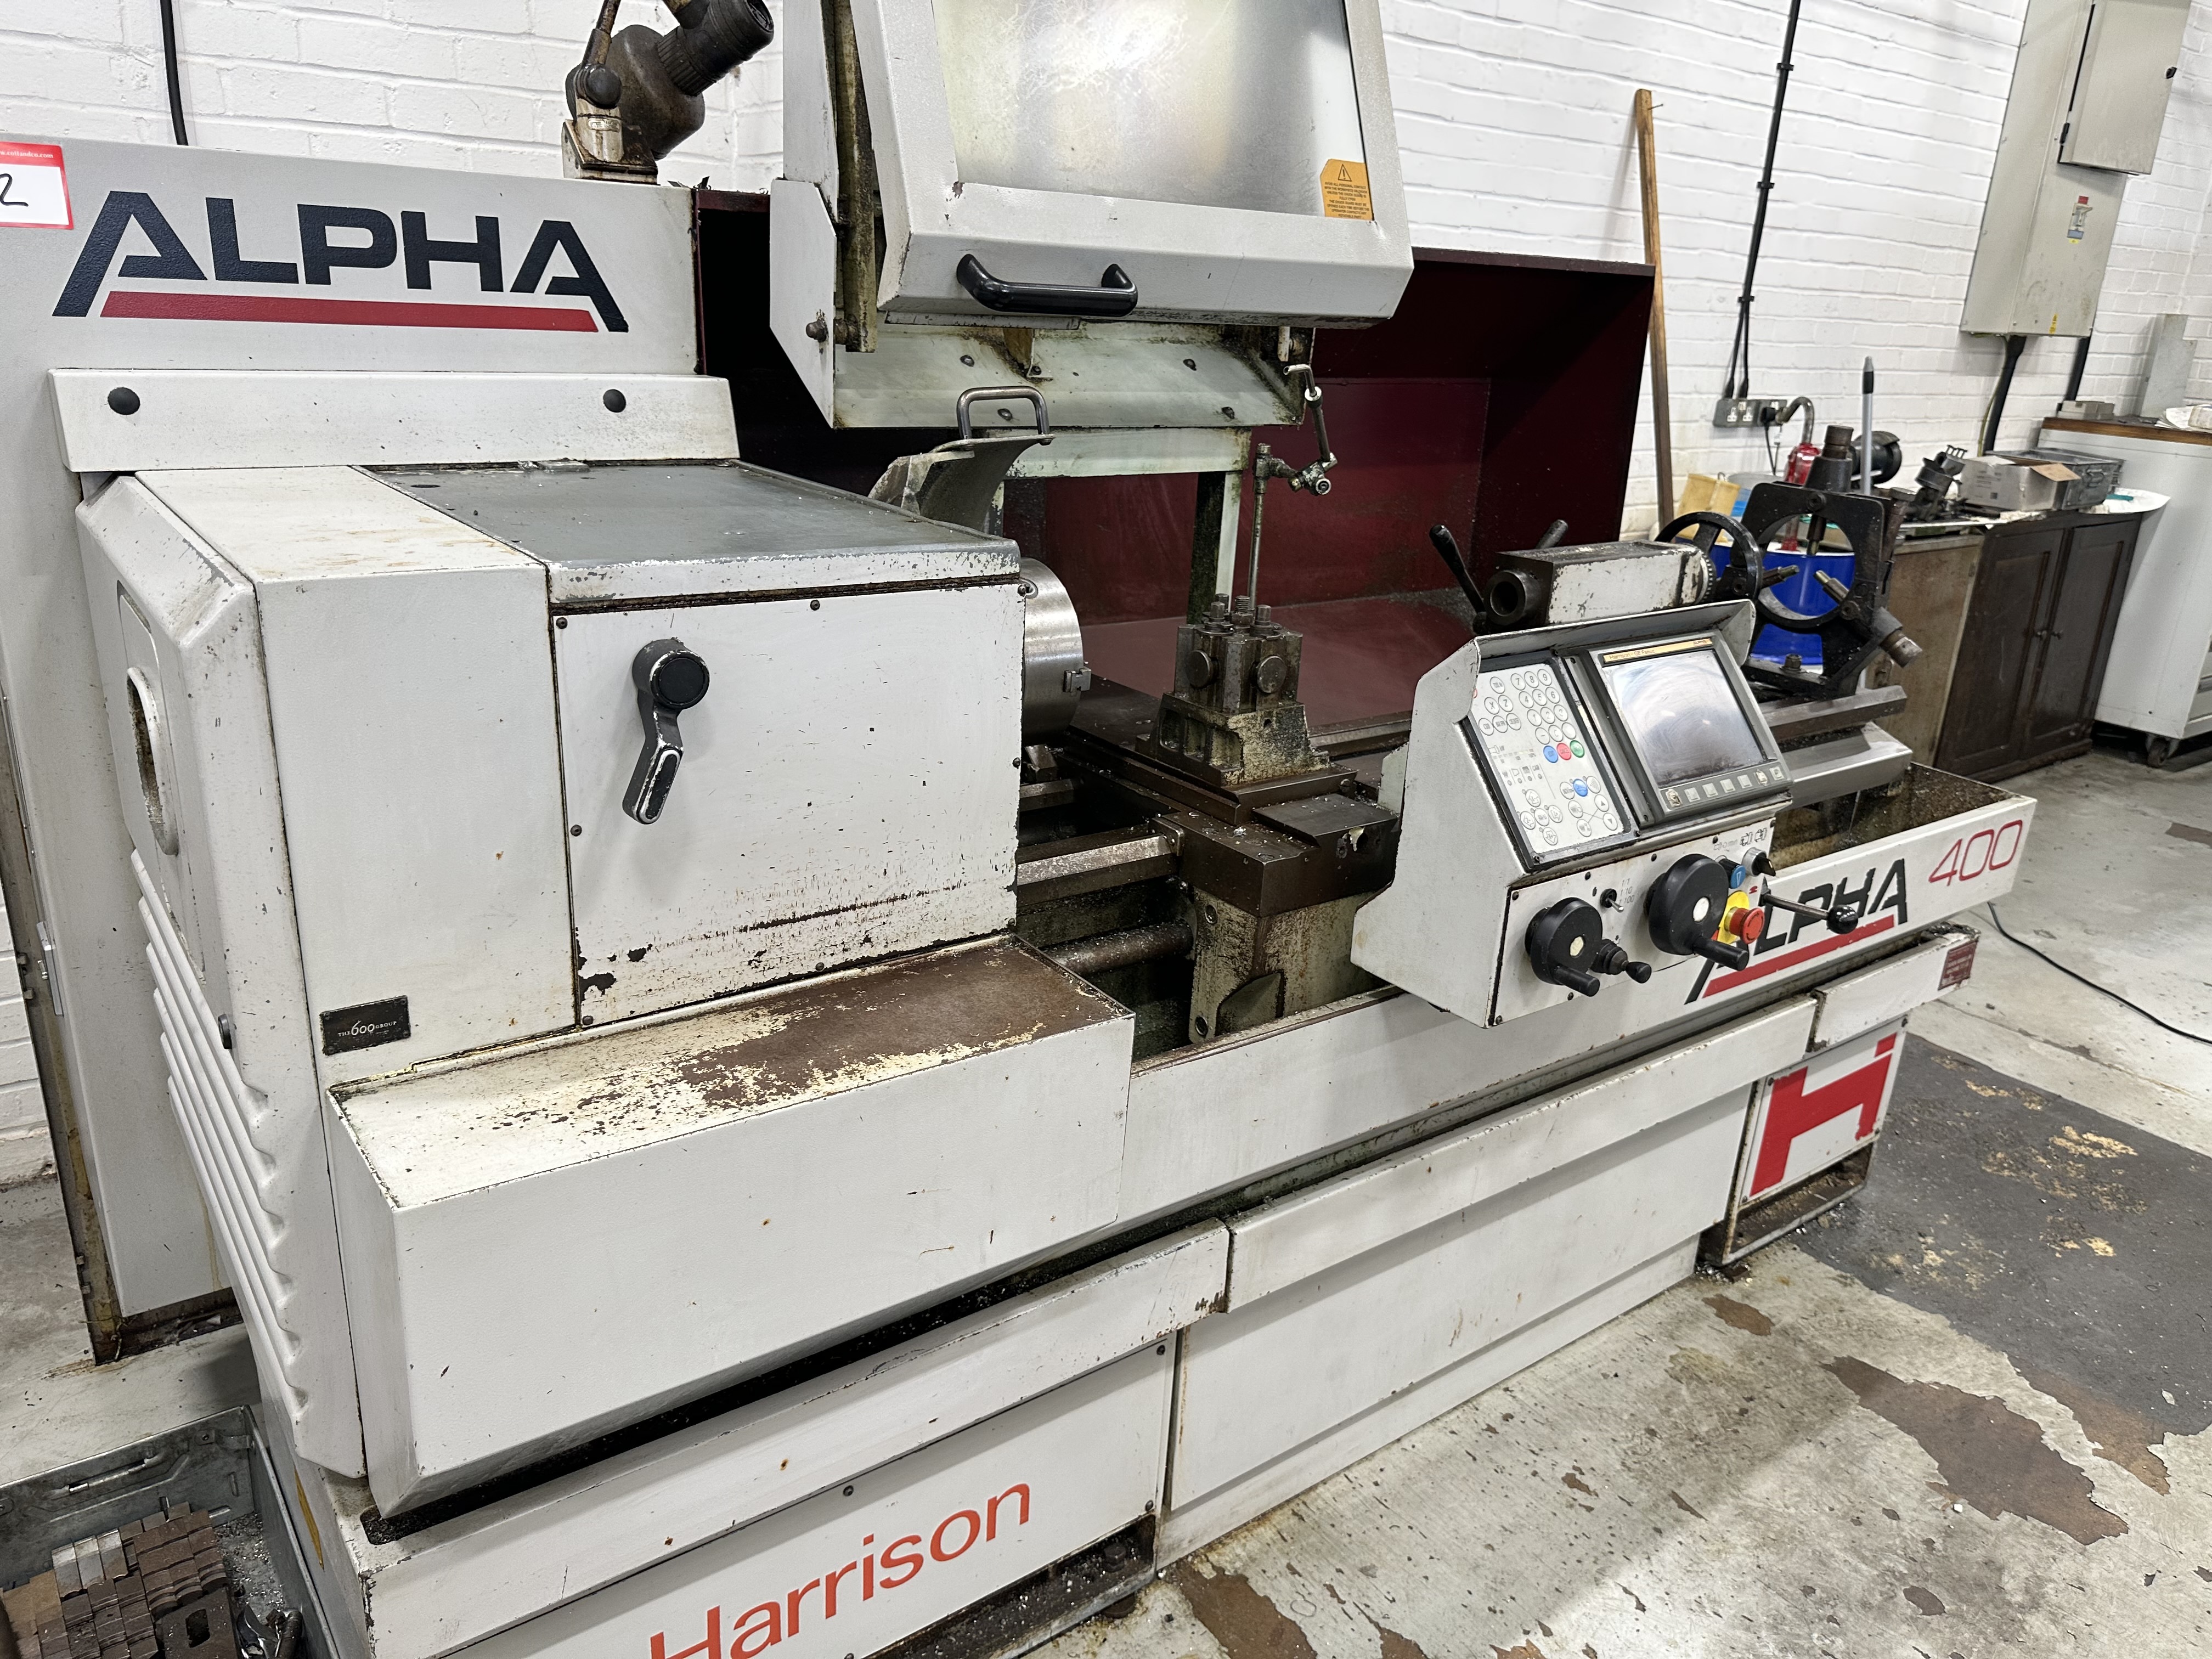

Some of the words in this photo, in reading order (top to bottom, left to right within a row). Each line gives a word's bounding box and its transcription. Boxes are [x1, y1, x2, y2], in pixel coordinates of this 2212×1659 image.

[52, 190, 629, 333] ALPHA
[1928, 819, 2023, 887] 400
[351, 1020, 375, 1036] 600
[375, 1020, 397, 1029] GROUP
[650, 1483, 1030, 1659] Harrison
